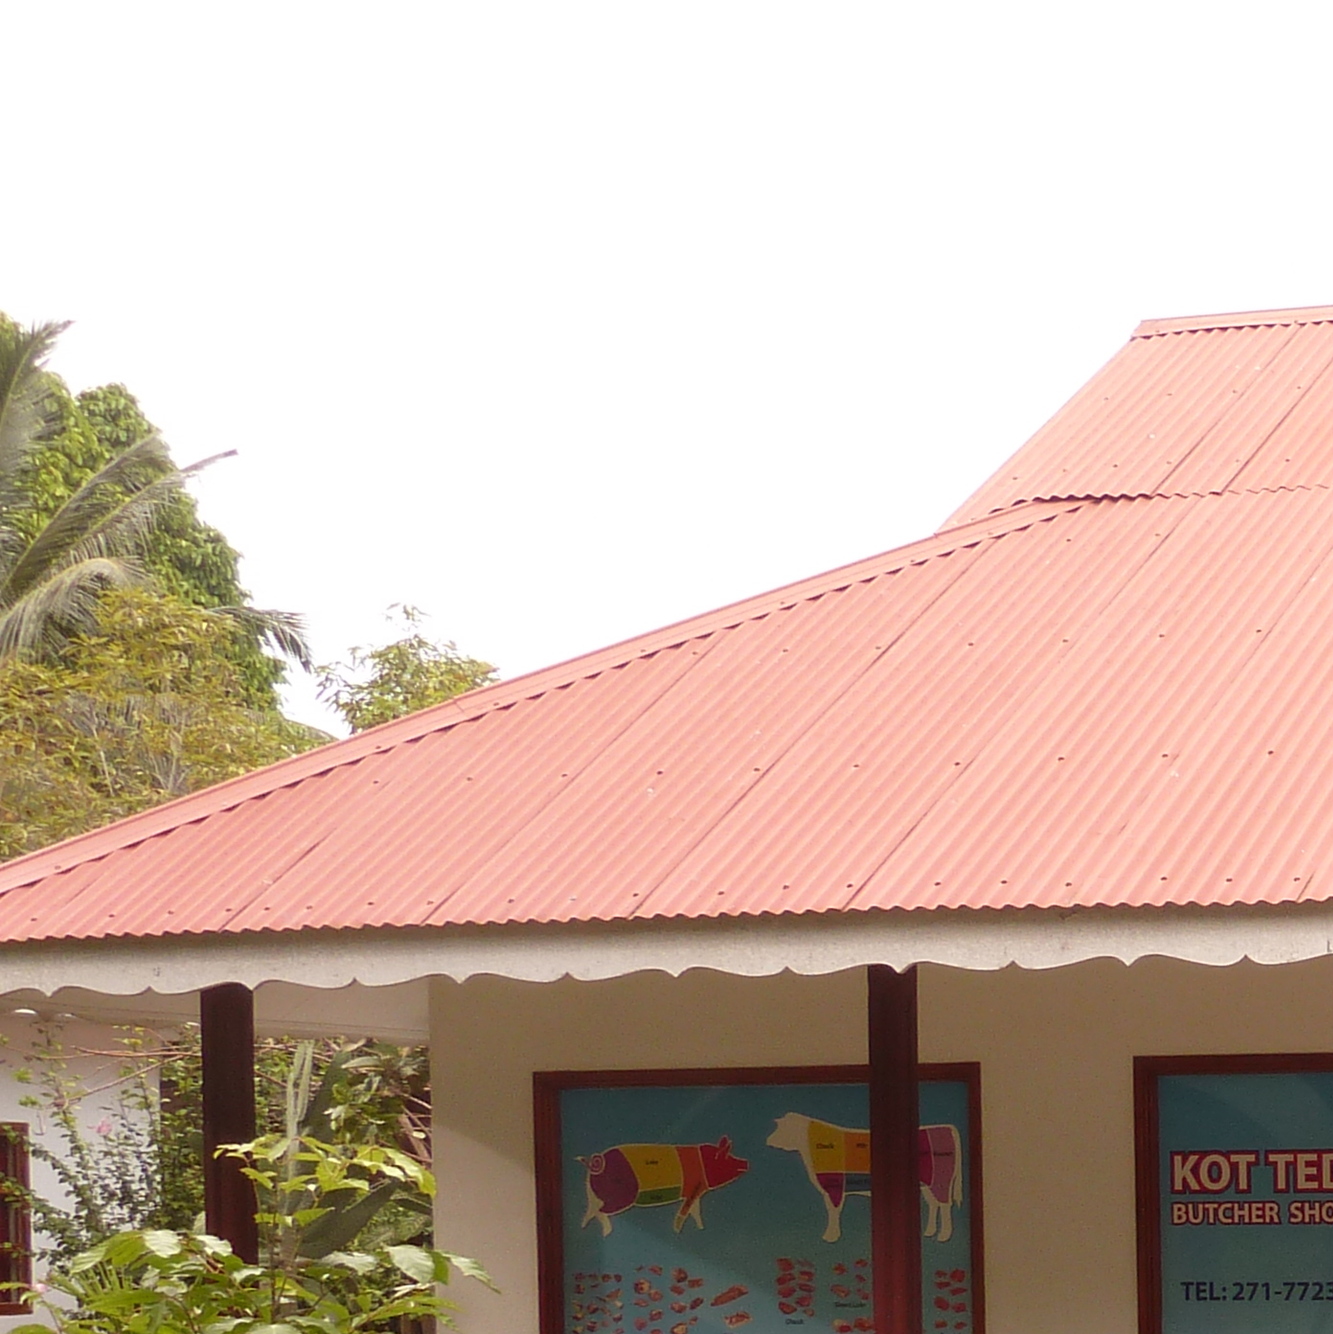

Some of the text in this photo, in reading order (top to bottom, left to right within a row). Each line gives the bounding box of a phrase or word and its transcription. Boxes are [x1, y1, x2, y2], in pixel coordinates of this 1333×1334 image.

[1170, 1150, 1259, 1194] KOT
[1171, 1200, 1282, 1226] BUTCHER
[1180, 1281, 1228, 1302] TEL:
